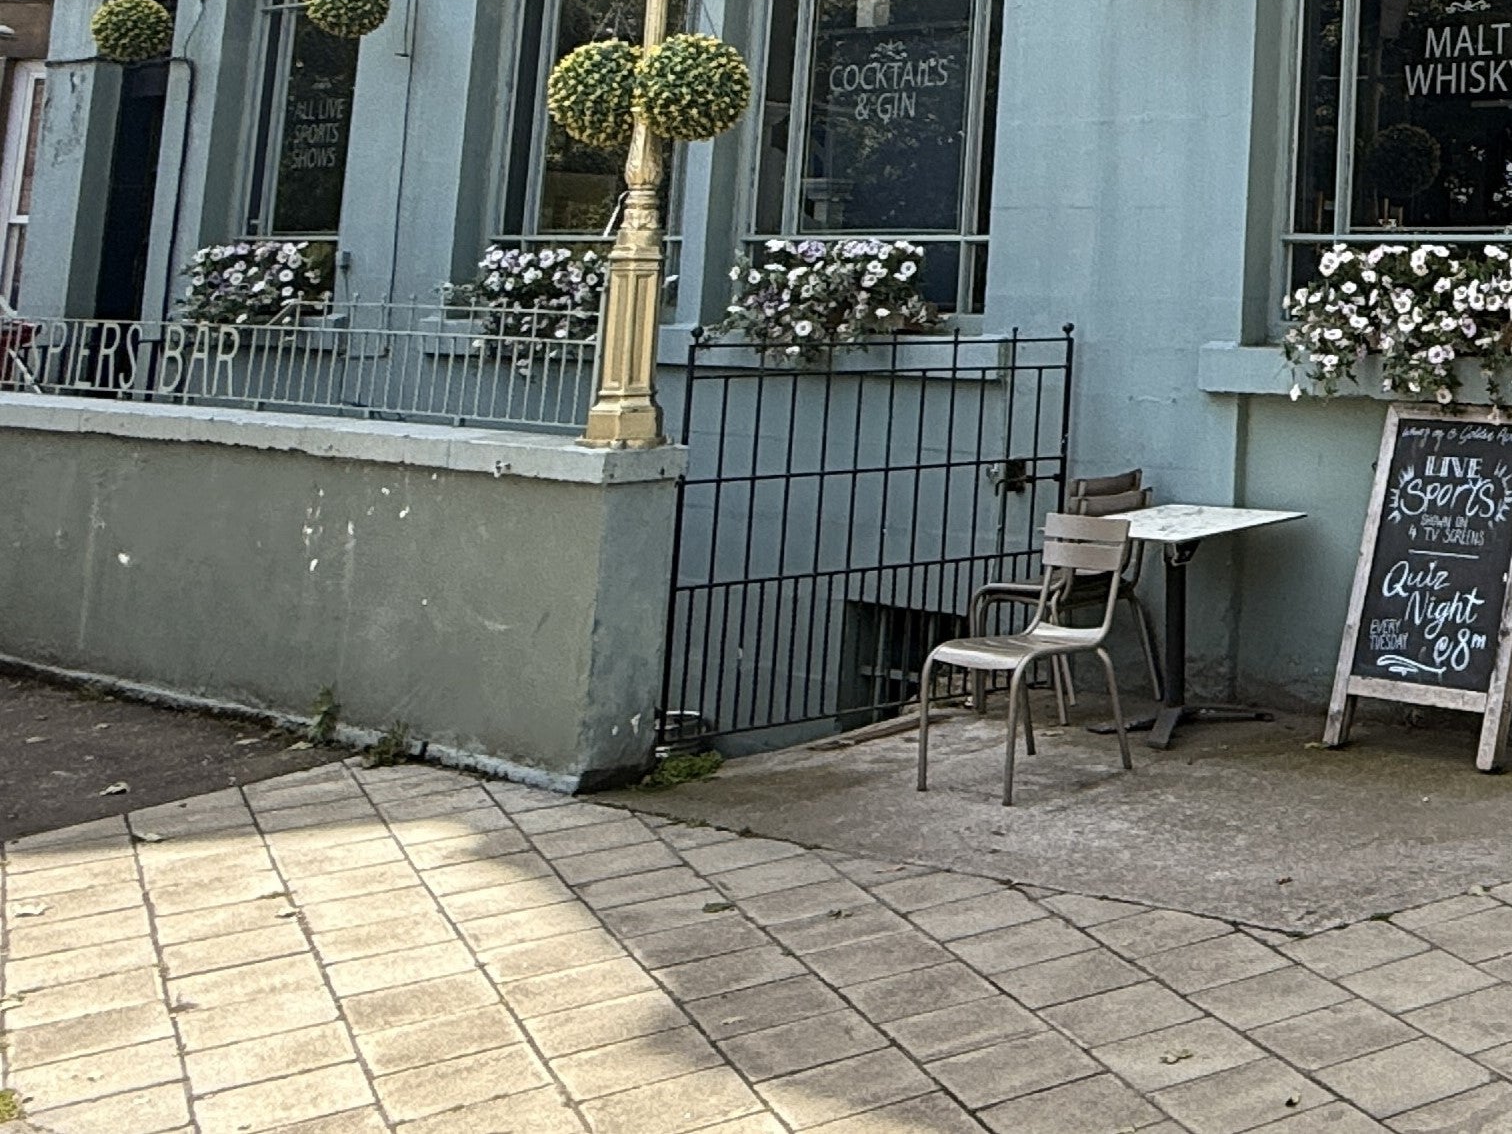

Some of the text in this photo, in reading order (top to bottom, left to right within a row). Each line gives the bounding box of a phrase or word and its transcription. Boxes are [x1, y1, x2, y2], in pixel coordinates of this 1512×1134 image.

[1424, 22, 1511, 58] MALT
[830, 58, 948, 91] COCKTAILS
[318, 97, 345, 120] LIVE
[855, 92, 917, 120] & GIN
[293, 123, 339, 144] SPORTS
[159, 324, 240, 398] BAR
[1424, 455, 1483, 479] LIVE
[1424, 526, 1440, 541] TV
[1442, 528, 1484, 546] SCREENS
[1382, 560, 1451, 597] Quiz
[1405, 586, 1485, 639] Night
[1370, 618, 1402, 634] EVERY
[1369, 632, 1409, 650] TUESDAY
